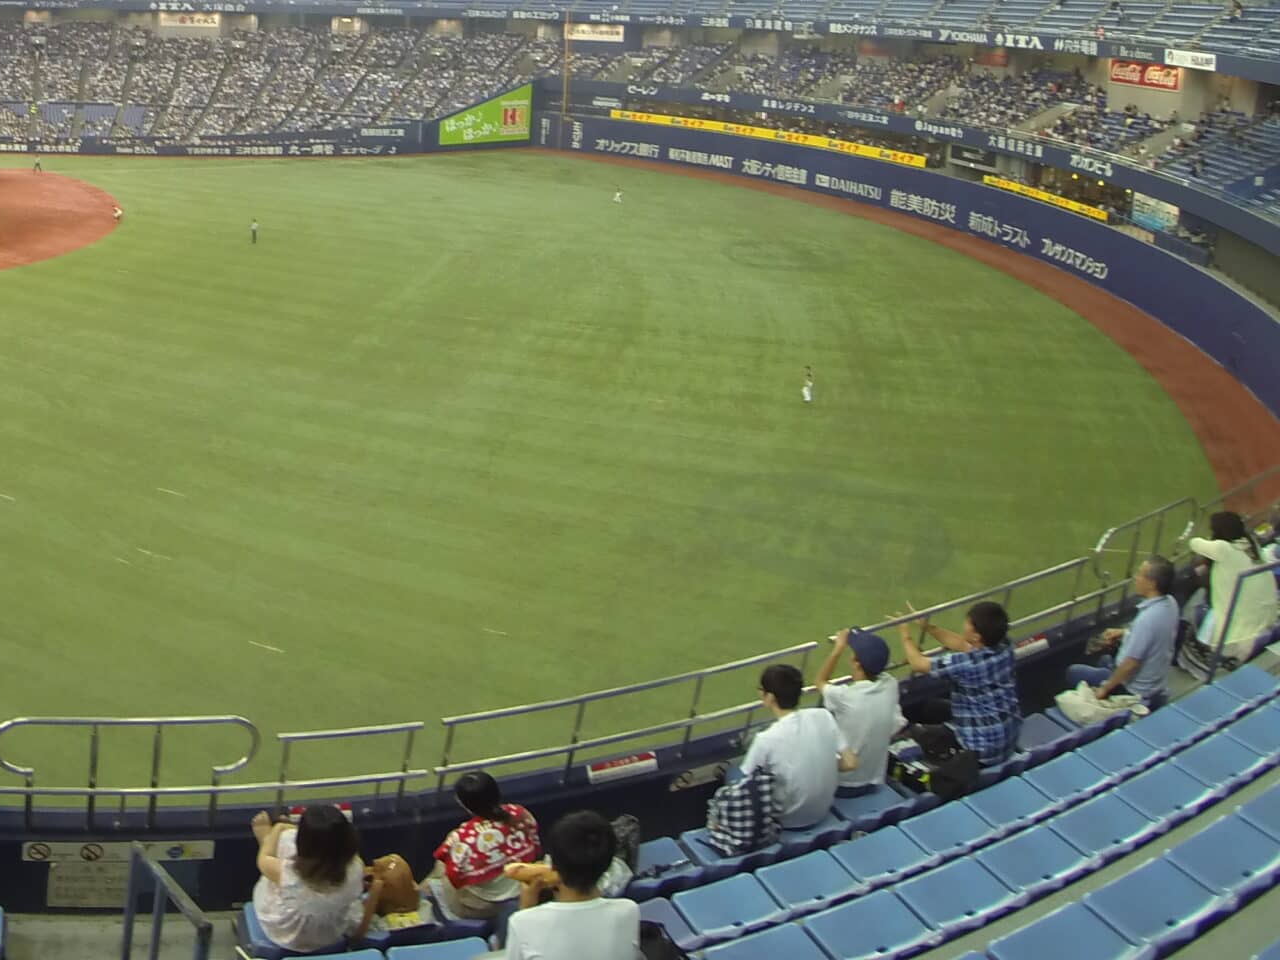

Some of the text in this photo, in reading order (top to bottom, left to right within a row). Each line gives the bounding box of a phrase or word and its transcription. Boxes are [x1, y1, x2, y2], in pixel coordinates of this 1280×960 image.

[939, 29, 988, 43] YOKOHAMA
[1005, 33, 1044, 50] ITA
[1112, 63, 1141, 82] Coca-Cola
[1144, 66, 1177, 86] Coca-Cola
[627, 85, 658, 95] セーレン
[594, 138, 660, 159] オリックス銀行
[709, 154, 734, 169] MAST
[830, 177, 882, 201] DAIHATSU
[890, 189, 957, 224] 能美防災
[968, 211, 1031, 248] 新成トラスト
